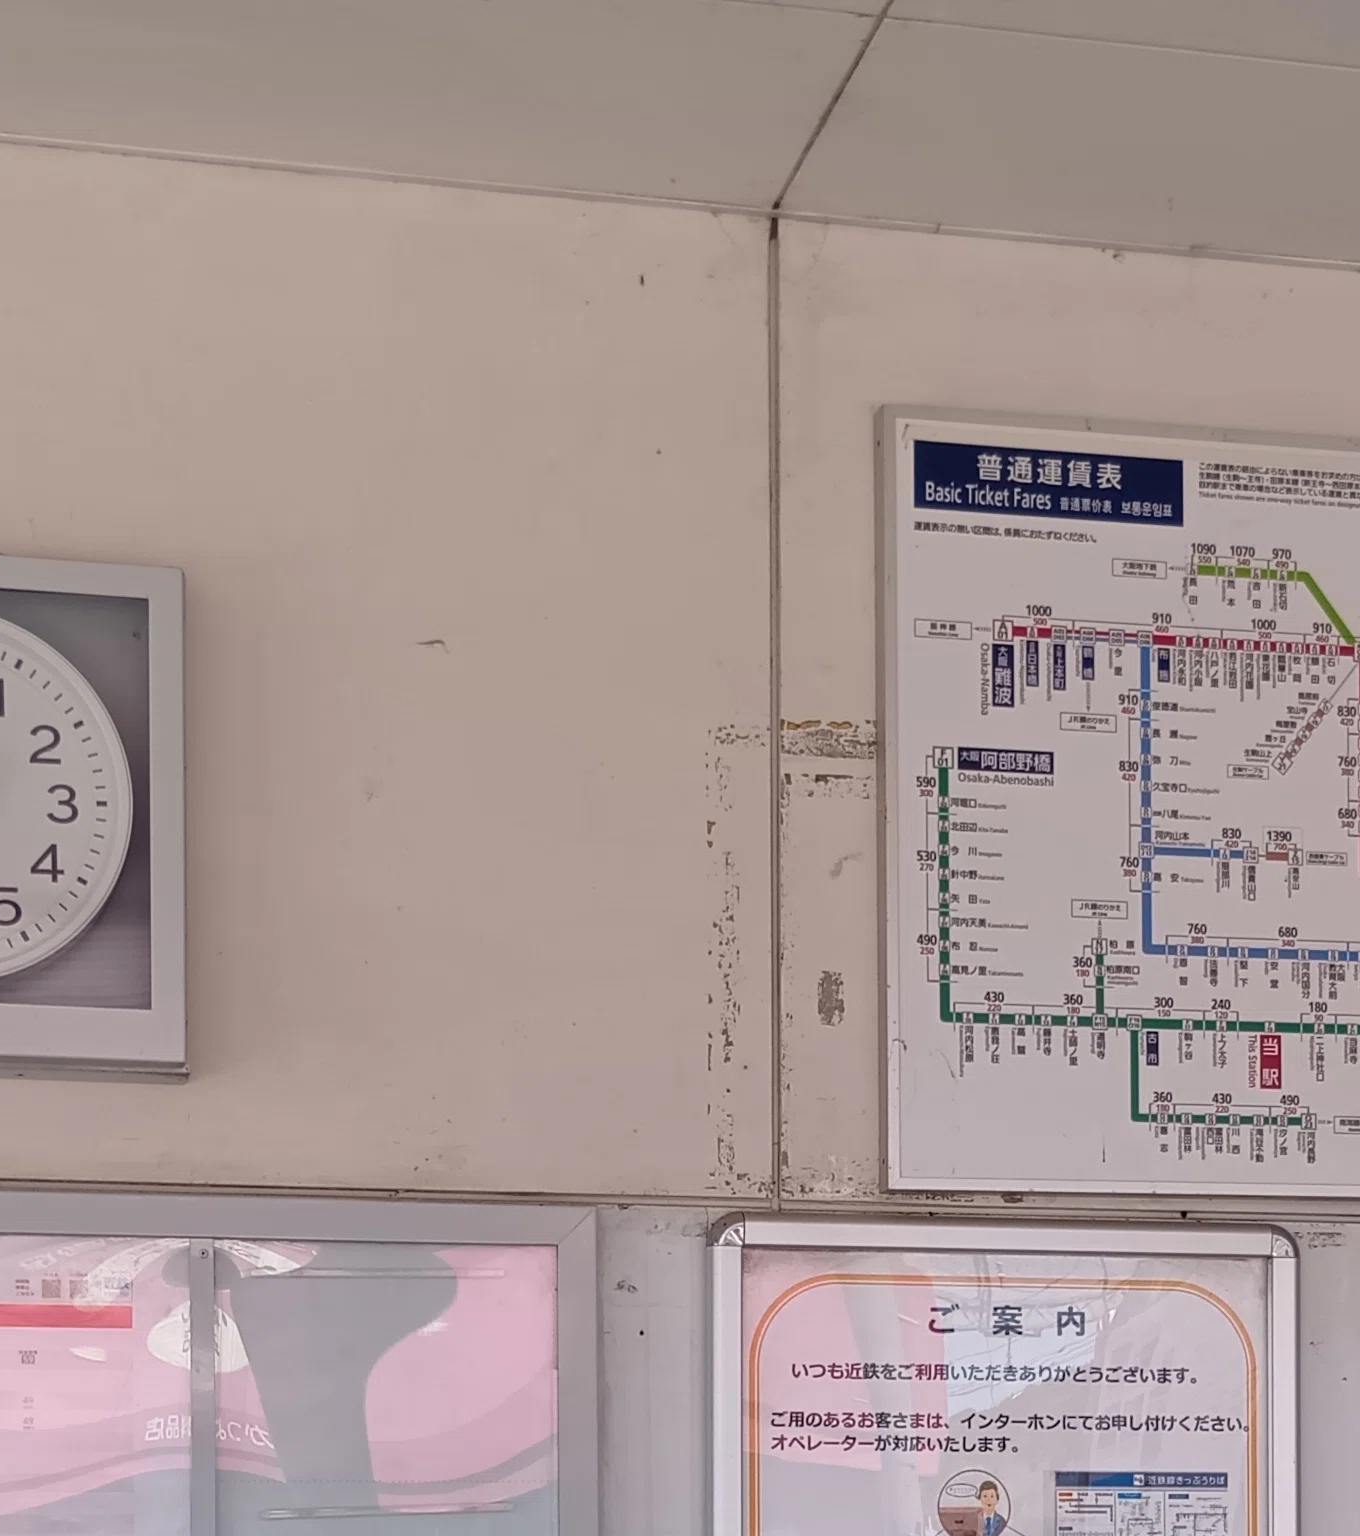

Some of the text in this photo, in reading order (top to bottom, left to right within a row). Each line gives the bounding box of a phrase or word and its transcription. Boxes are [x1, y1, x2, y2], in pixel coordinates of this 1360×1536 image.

[977, 453, 1122, 490] 普通運賃表
[925, 481, 1052, 510] Basic Ticket Fares
[1191, 543, 1216, 555] 1090
[1026, 605, 1052, 617] 1000
[980, 643, 990, 716] Osaka-Namba
[994, 646, 1014, 706] 大阪難波
[30, 724, 62, 765] 2
[960, 751, 1051, 773] 大阪阿部野橋
[916, 777, 936, 788] 590
[958, 772, 1054, 787] Osaka-Abenobashi
[46, 783, 78, 824] 3
[30, 844, 64, 883] 4
[1154, 997, 1174, 1009] 300
[1308, 1002, 1328, 1014] 180
[1248, 1035, 1258, 1088] This Station
[1262, 1037, 1279, 1087] 当駅
[928, 1304, 1086, 1337] ご案内
[792, 1362, 1199, 1385] いつも近鉄をご利用いただきありがとうございます。
[770, 1411, 1251, 1434] ご用のあるお客さまは、インターホンにてお申し付けください。
[770, 1434, 1020, 1455] オペレーターが対応いたします。
[1148, 1475, 1225, 1485] 近鉄線きっぷうりば
